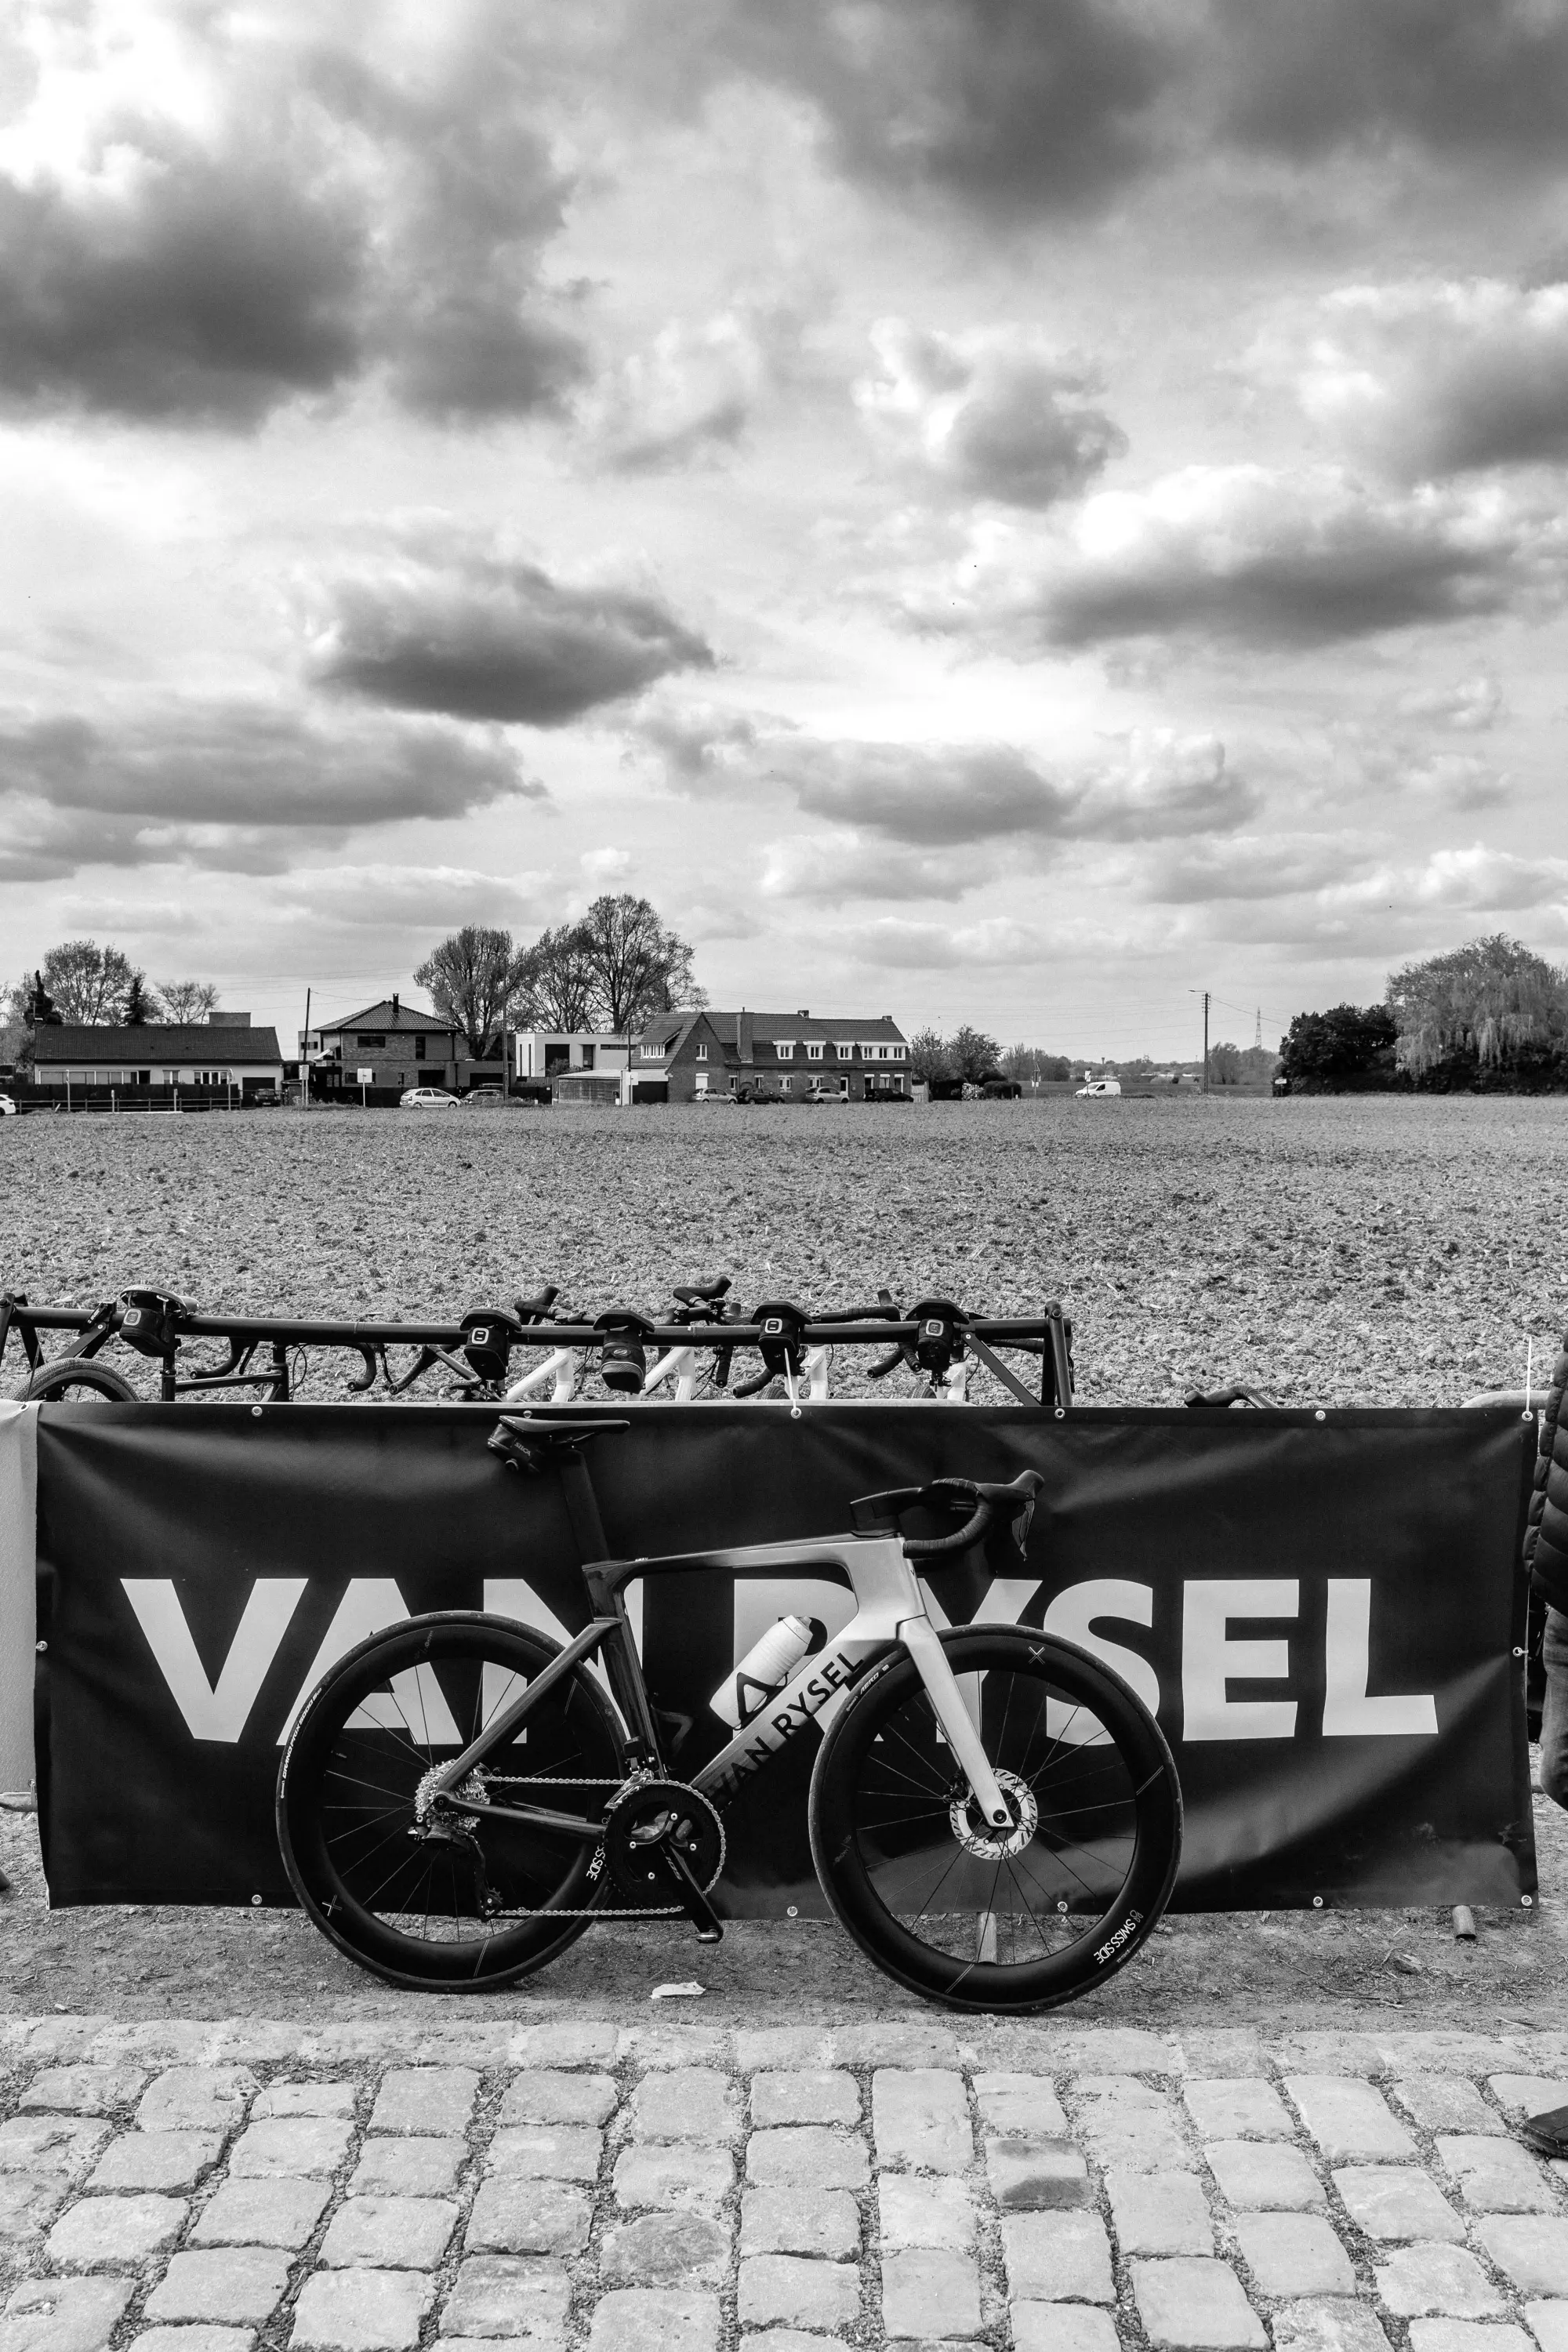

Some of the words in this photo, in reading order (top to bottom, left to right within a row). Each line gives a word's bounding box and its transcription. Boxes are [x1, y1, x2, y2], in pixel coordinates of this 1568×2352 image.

[514, 1442, 531, 1457] SILCA
[860, 1671, 879, 1694] AERO
[290, 1724, 300, 1747] PRIX
[299, 1699, 314, 1726] 5000
[708, 1736, 775, 1798] VAN
[771, 1653, 864, 1740] RYSEL
[586, 1857, 603, 1882] SIDE
[1110, 1918, 1136, 1948] SWISS
[1093, 1942, 1115, 1964] SIDE
